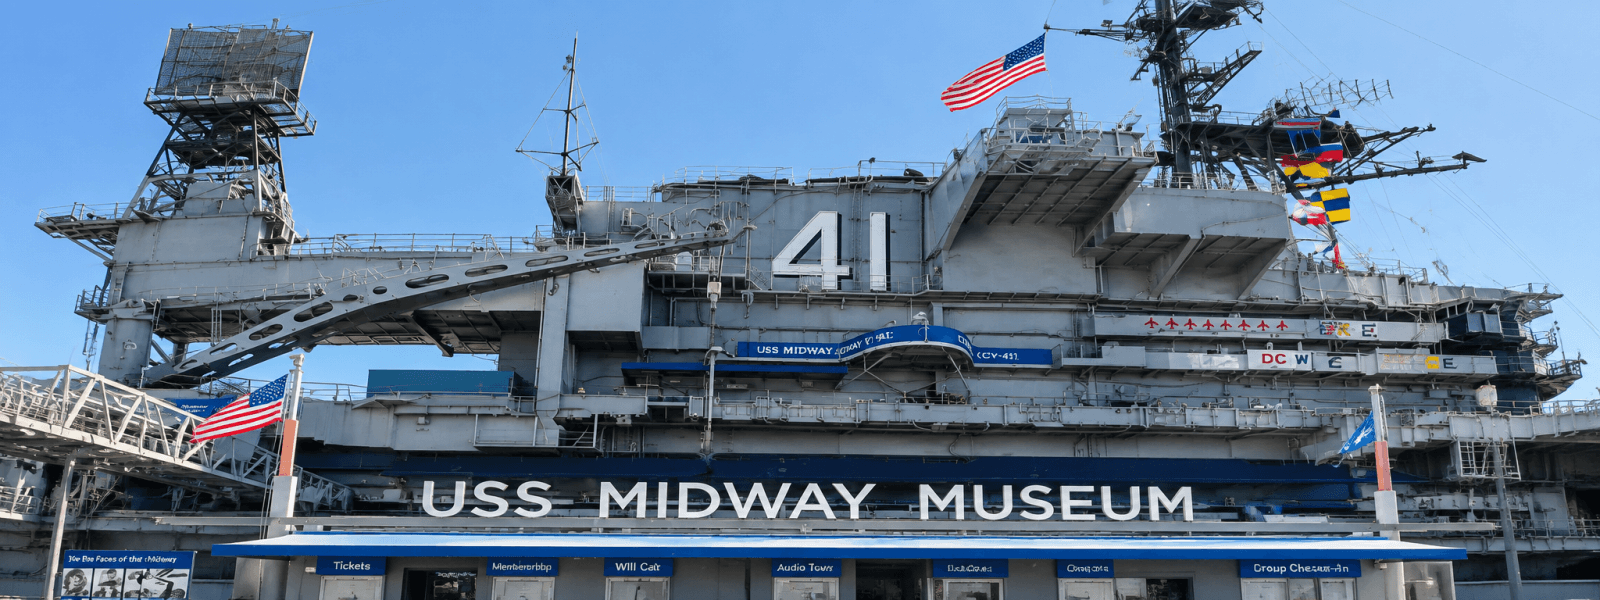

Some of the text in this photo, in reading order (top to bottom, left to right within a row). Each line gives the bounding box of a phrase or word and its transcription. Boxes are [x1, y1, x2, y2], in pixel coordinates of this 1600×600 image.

[772, 211, 889, 291] 41
[757, 346, 779, 354] USS
[783, 346, 834, 356] MIDWAY
[422, 480, 1194, 521] USS MIDWAY MUSEUM
[333, 561, 371, 571] Tickets
[777, 563, 806, 572] Audio
